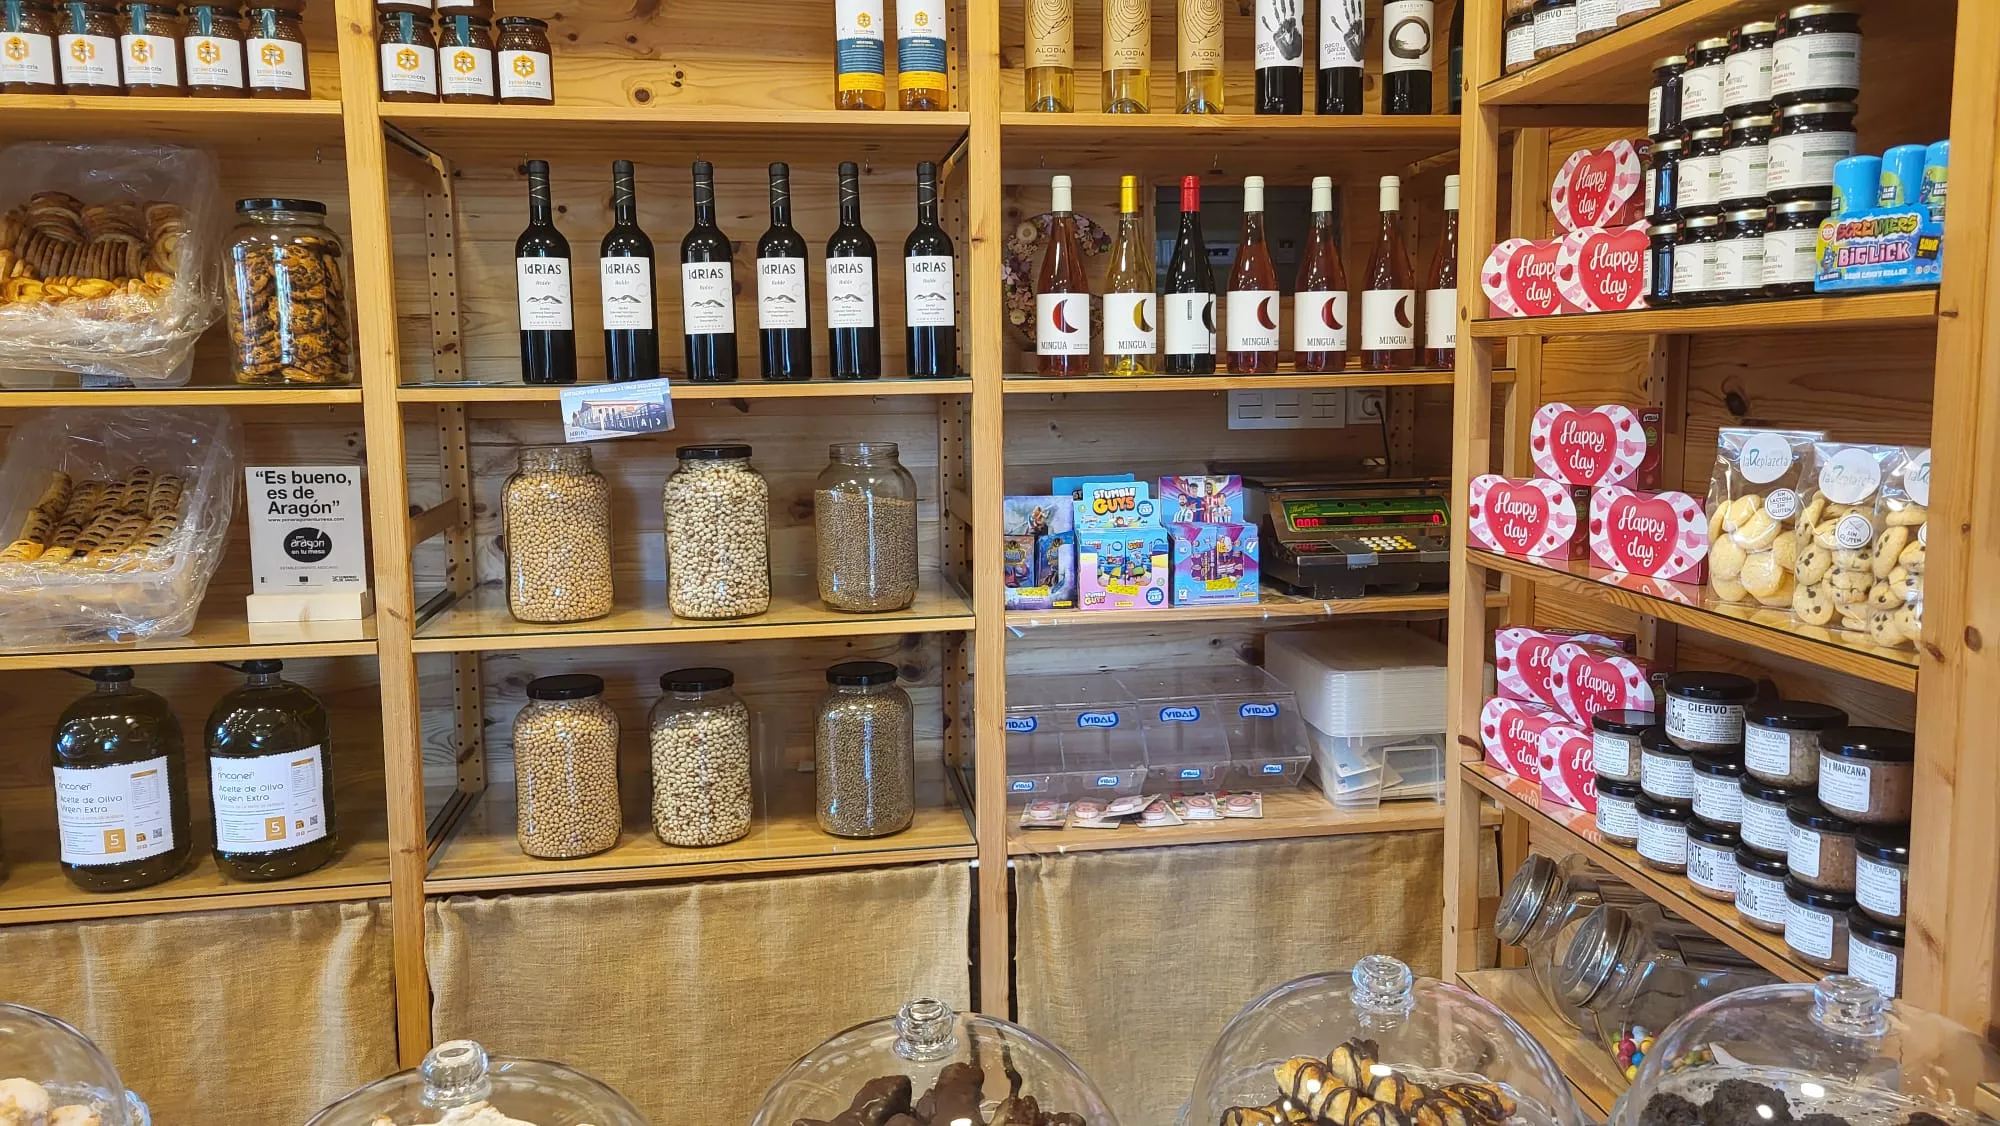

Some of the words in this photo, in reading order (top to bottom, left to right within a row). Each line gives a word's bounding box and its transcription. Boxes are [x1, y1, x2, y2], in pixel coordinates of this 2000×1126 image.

[1536, 9, 1562, 23] CIERVO
[1114, 49, 1145, 57] ALODIA
[1190, 50, 1221, 58] ALODIA
[1575, 164, 1607, 192] Happy
[1578, 194, 1597, 221] day
[1836, 214, 1918, 241] SCREAMERS
[1590, 243, 1639, 274] Happy
[1600, 273, 1628, 301] day
[1526, 281, 1552, 309] day
[1040, 341, 1067, 350] MINGUA
[1118, 340, 1147, 350] MINGUA
[1241, 337, 1270, 346] MINGUA
[1306, 337, 1336, 346] MINGUA
[1378, 335, 1407, 345] MINGUA
[1559, 420, 1605, 452] Happy
[1569, 452, 1595, 478] day
[291, 470, 352, 486] bueno,
[266, 488, 288, 500] es
[292, 485, 315, 500] de
[1093, 487, 1137, 499] STUMBLE
[1092, 497, 1136, 515] GUYS
[1494, 491, 1538, 524] Happy
[1618, 505, 1666, 539] Happy
[1503, 520, 1528, 547] day
[1839, 534, 1862, 544] GLUTEN
[1846, 530, 1858, 538] SIN
[1627, 536, 1654, 568] day
[1084, 595, 1106, 606] GUYS
[1576, 664, 1616, 702] Happy
[1164, 709, 1196, 719] VIDAL
[1244, 705, 1276, 715] VIDAL
[1687, 702, 1728, 715] CIERVO
[1082, 715, 1115, 725] VIDAL
[1516, 748, 1539, 775] day
[1265, 765, 1282, 773] VIDAL
[1832, 763, 1867, 778] MANZANA
[1100, 777, 1117, 785] VIDAL
[219, 785, 242, 793] Aceite
[244, 785, 257, 793] de
[82, 796, 95, 804] de
[219, 795, 243, 803] Virgen
[246, 795, 270, 803] Extra
[61, 804, 82, 815] Virgen
[84, 806, 108, 814] Extra
[1664, 825, 1685, 834] ROMERO
[1873, 863, 1898, 877] ROMERO
[1806, 910, 1830, 924] ROMERO
[1868, 948, 1894, 962] ROMERO
